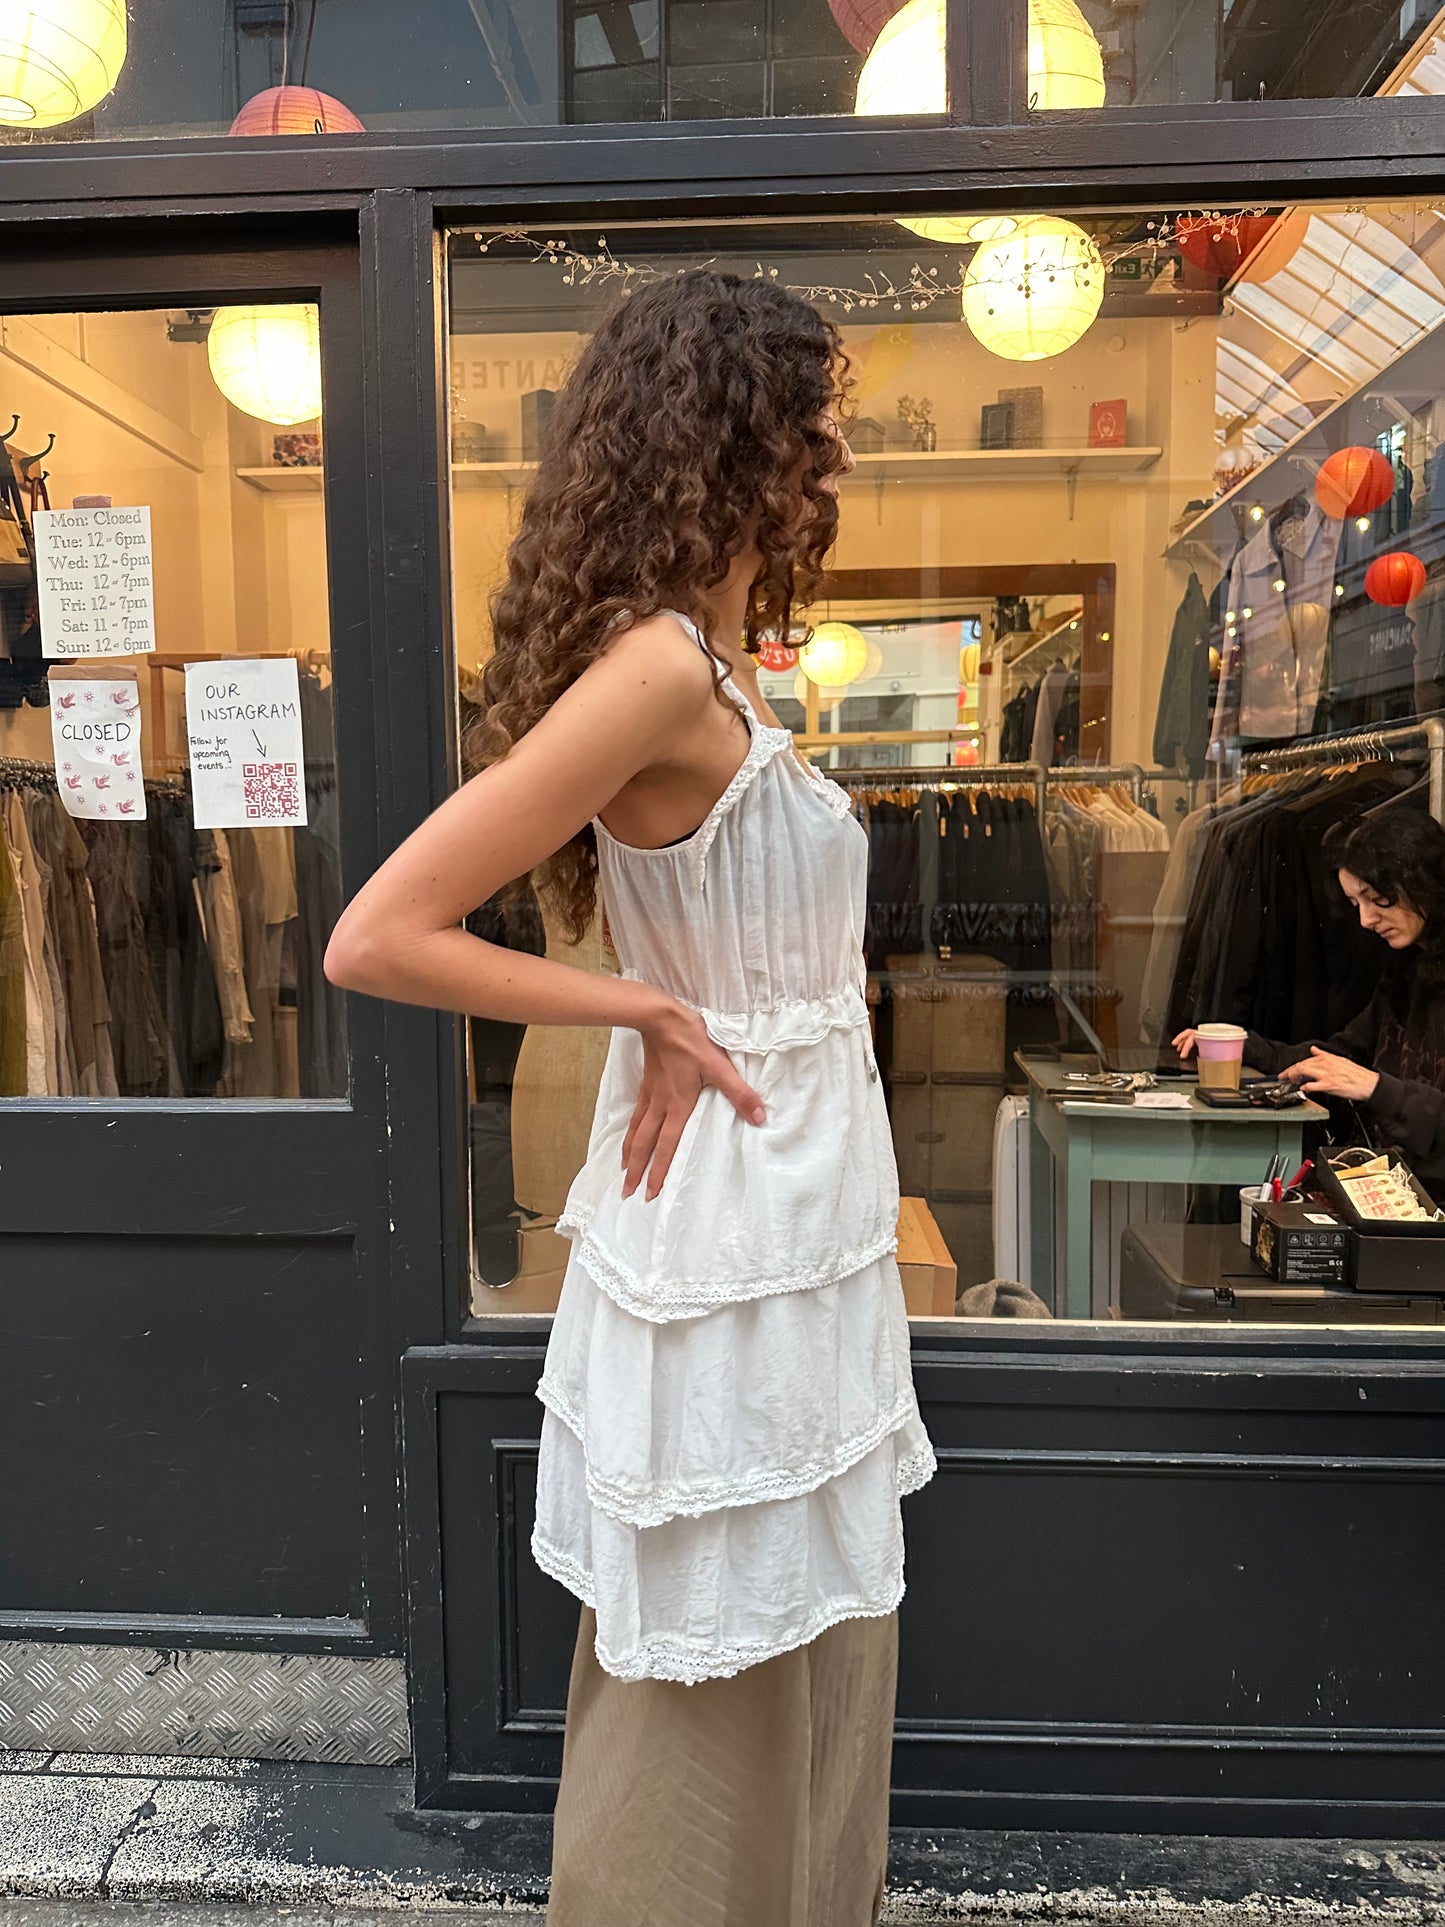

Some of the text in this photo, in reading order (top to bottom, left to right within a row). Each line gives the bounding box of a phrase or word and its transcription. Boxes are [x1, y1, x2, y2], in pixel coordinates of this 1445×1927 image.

[50, 509, 142, 528] Mon: Closed
[49, 535, 82, 549] Tue:
[48, 556, 89, 570] Wed:
[46, 577, 83, 591] Thu:
[60, 598, 86, 611] Fri:
[62, 619, 89, 632] Sat:
[56, 640, 90, 653] Sun:
[205, 683, 240, 699] OUR
[201, 703, 296, 721] INSTAGRAM
[62, 722, 131, 742] CLOSED
[190, 736, 228, 751] Follow for
[193, 750, 232, 763] upcoming
